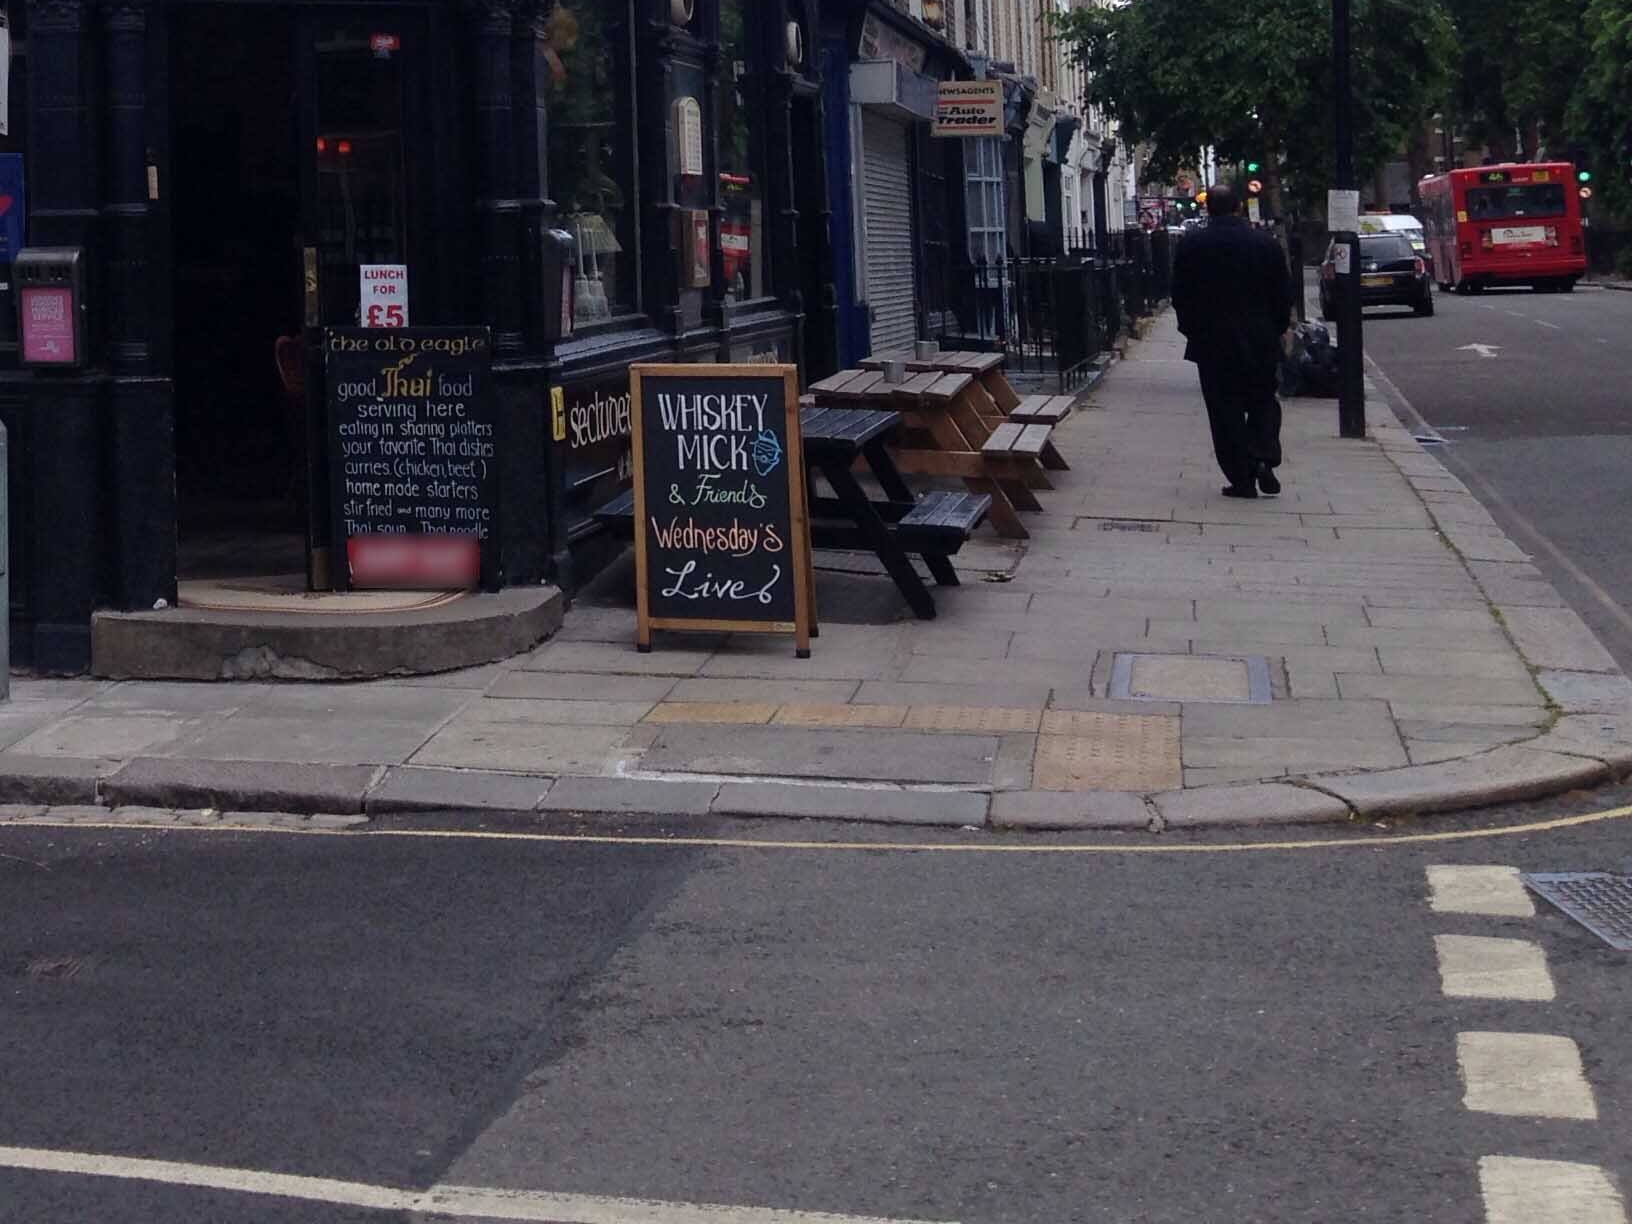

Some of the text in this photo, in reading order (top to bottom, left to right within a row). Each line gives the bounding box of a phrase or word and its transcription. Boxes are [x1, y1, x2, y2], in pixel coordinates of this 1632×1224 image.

[364, 270, 405, 280] LUNCH
[373, 285, 396, 295] FOR
[366, 304, 405, 328] £5
[330, 336, 485, 356] the old eagle
[337, 367, 473, 402] good Thai food
[357, 400, 466, 422] serving here
[658, 394, 767, 432] WHISKEY
[382, 421, 394, 436] in
[400, 419, 446, 439] sharing
[450, 421, 493, 438] platters
[342, 441, 372, 458] your
[677, 435, 748, 470] MICK
[346, 478, 479, 501] home made starters
[669, 474, 767, 509] & Friends
[344, 499, 363, 517] stir
[415, 506, 451, 523] many
[456, 504, 491, 521] more
[661, 560, 781, 604] Live
